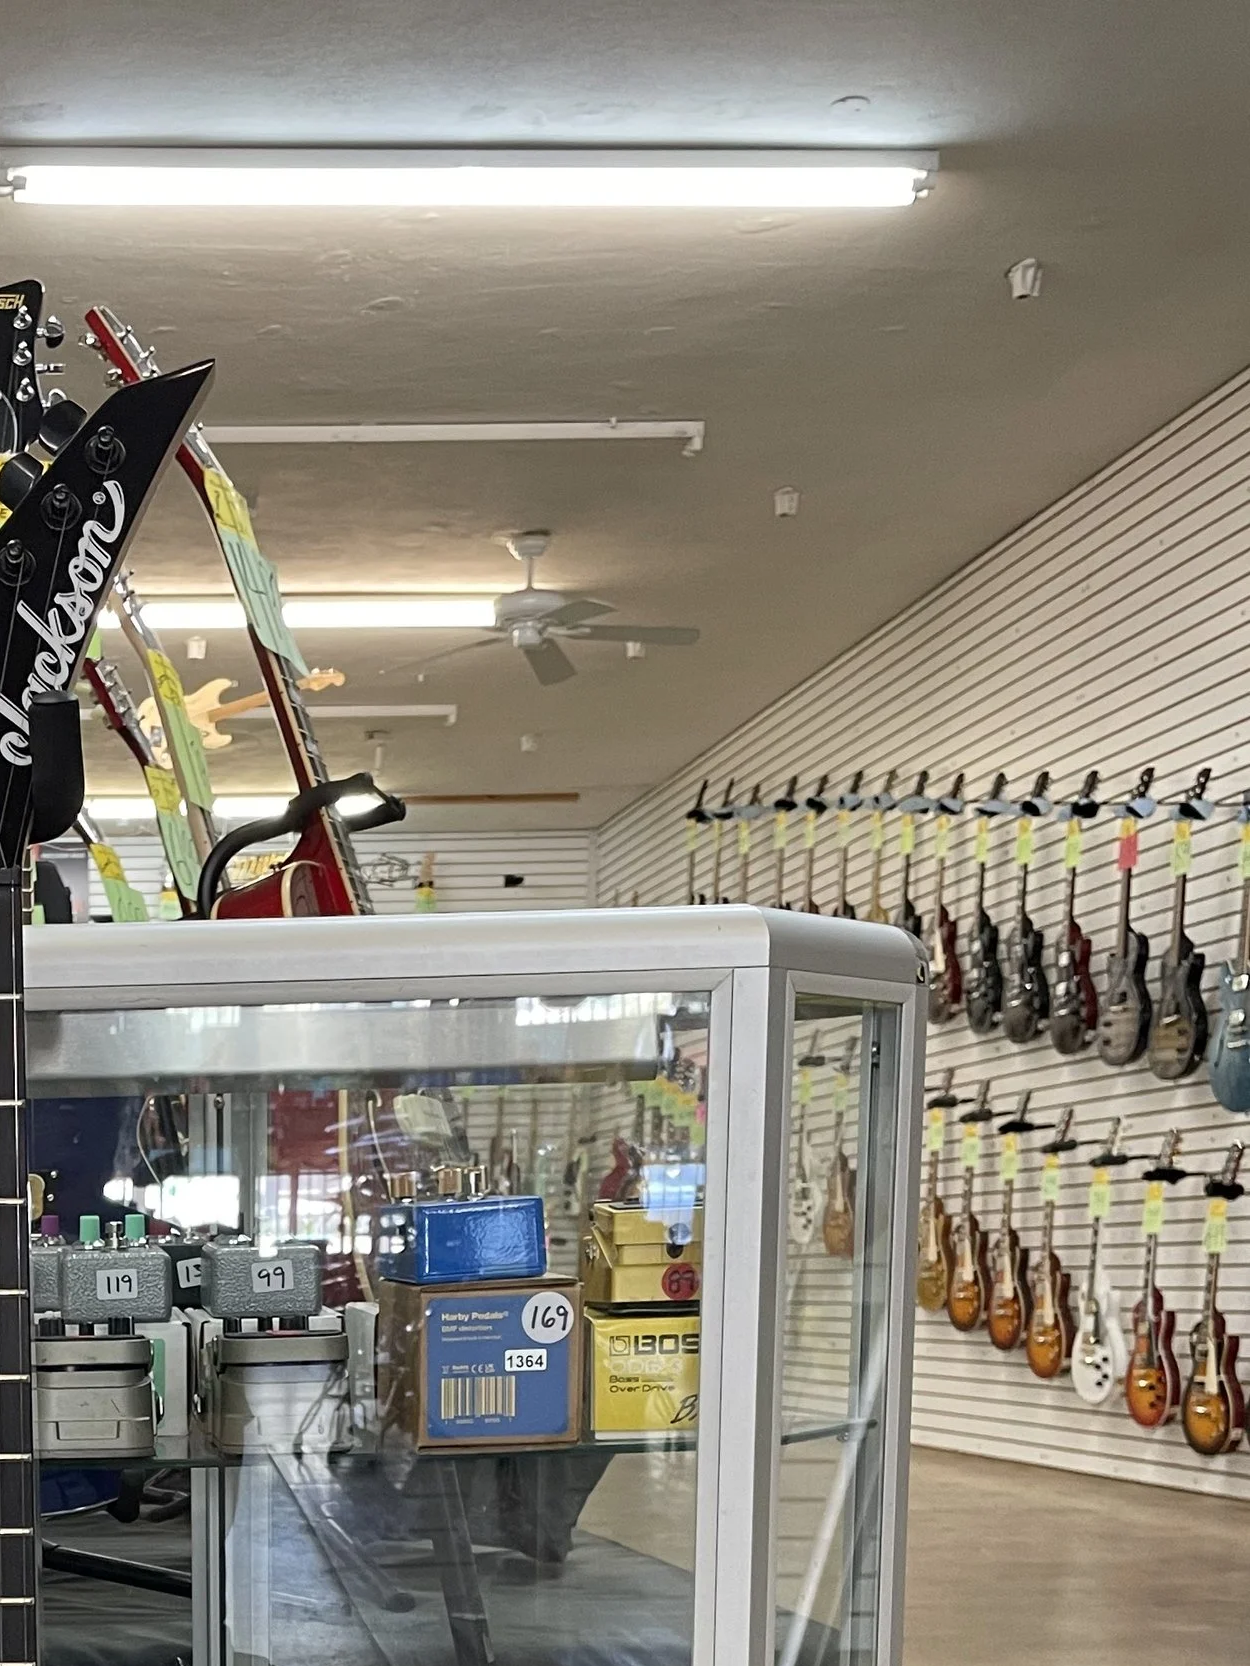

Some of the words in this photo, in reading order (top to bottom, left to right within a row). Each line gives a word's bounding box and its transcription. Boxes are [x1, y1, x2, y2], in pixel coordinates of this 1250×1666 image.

[106, 1275, 134, 1295] 119
[257, 1266, 286, 1289] 99
[531, 1304, 569, 1332] 169
[634, 1333, 700, 1355] BOS
[507, 1354, 545, 1368] 1364
[609, 1384, 641, 1393] Over
